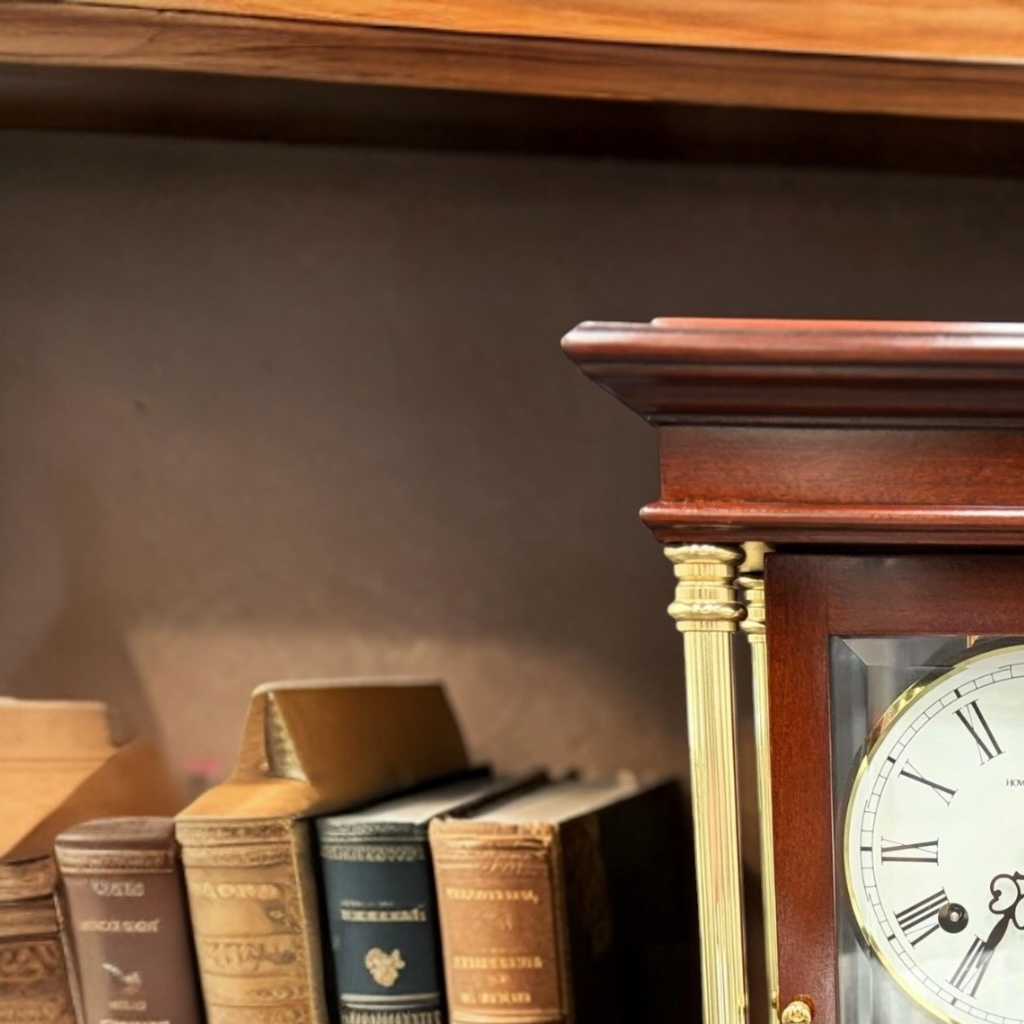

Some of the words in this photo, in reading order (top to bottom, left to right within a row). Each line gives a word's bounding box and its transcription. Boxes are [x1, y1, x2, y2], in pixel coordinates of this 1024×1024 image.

[952, 699, 1006, 766] XI
[898, 758, 958, 807] X
[881, 835, 939, 866] IX
[945, 934, 995, 999] VII
